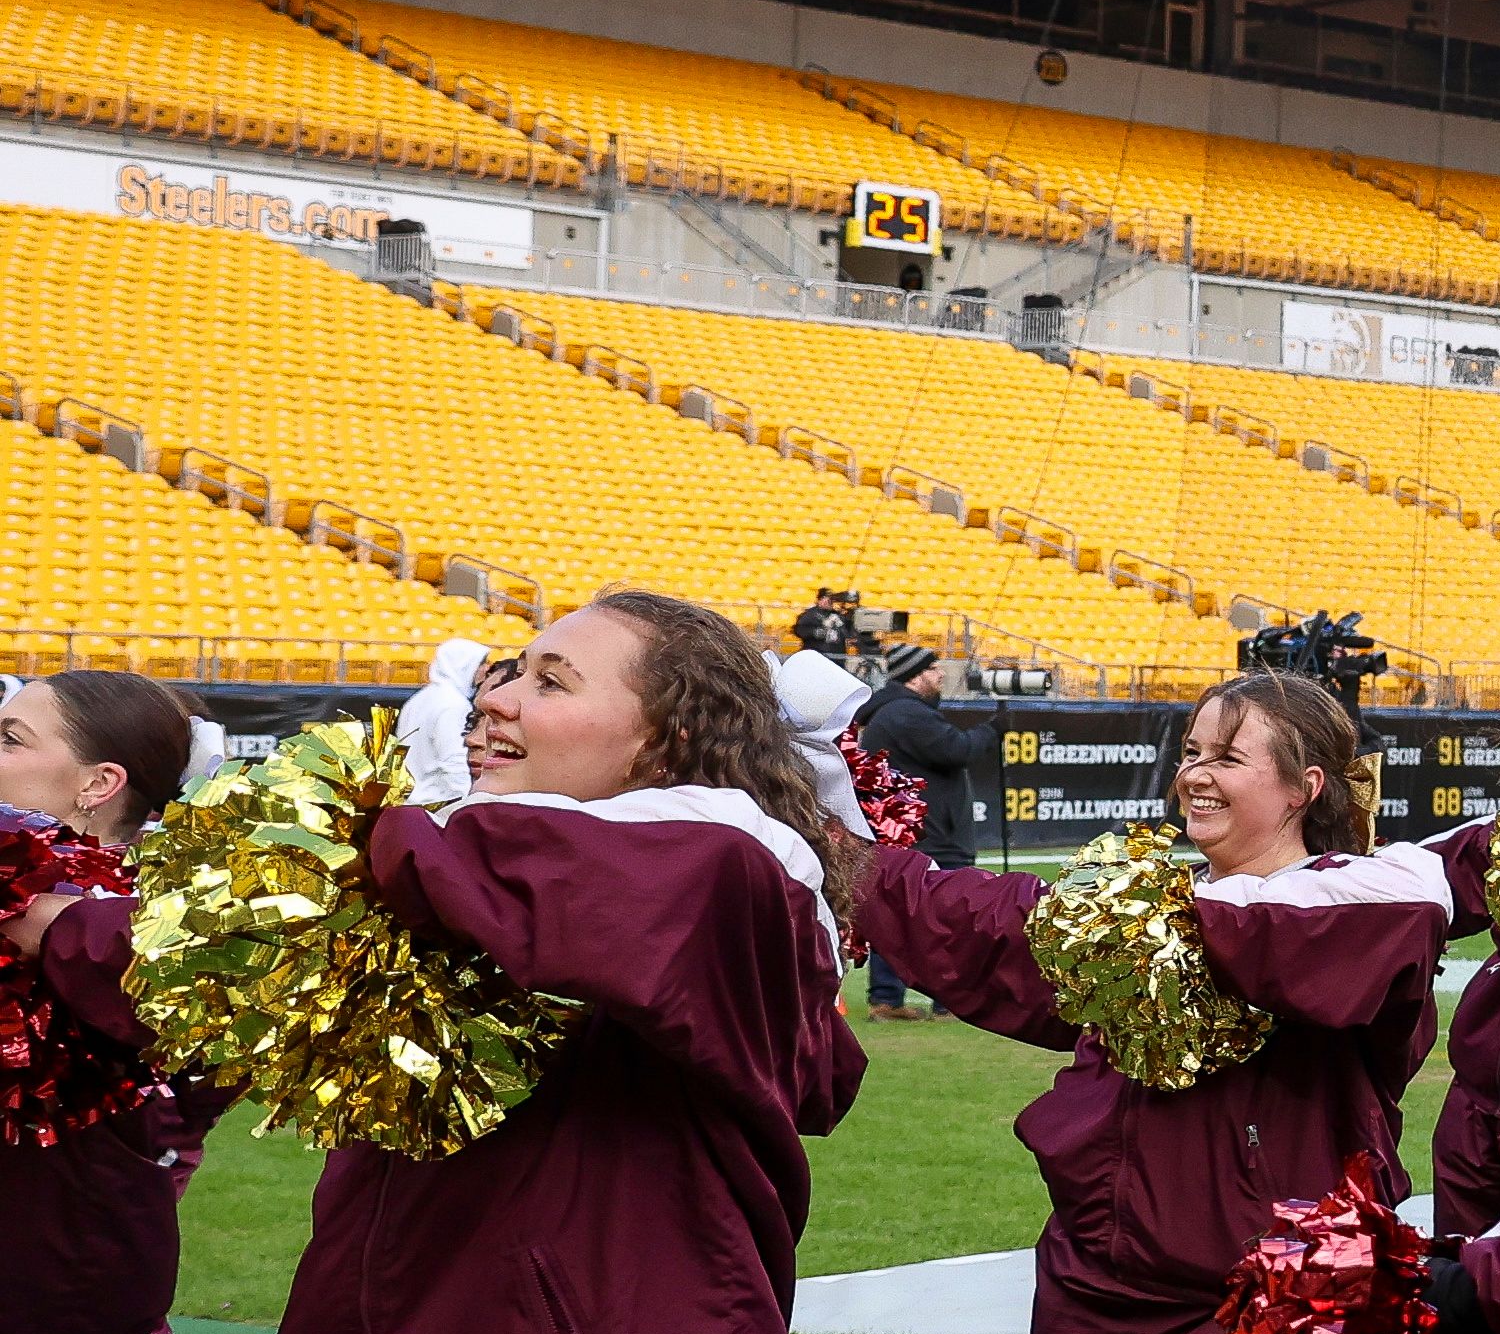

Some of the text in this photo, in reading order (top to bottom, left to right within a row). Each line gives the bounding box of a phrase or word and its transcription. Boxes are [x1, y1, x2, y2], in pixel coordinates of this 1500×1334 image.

[117, 165, 389, 241] Steelers.com
[867, 193, 925, 244] 25
[1004, 731, 1038, 764] 68
[1039, 744, 1156, 764] GREENWOOD
[1438, 736, 1461, 766] 91
[1037, 798, 1167, 820] STALLWORTH
[1432, 786, 1462, 817] 88
